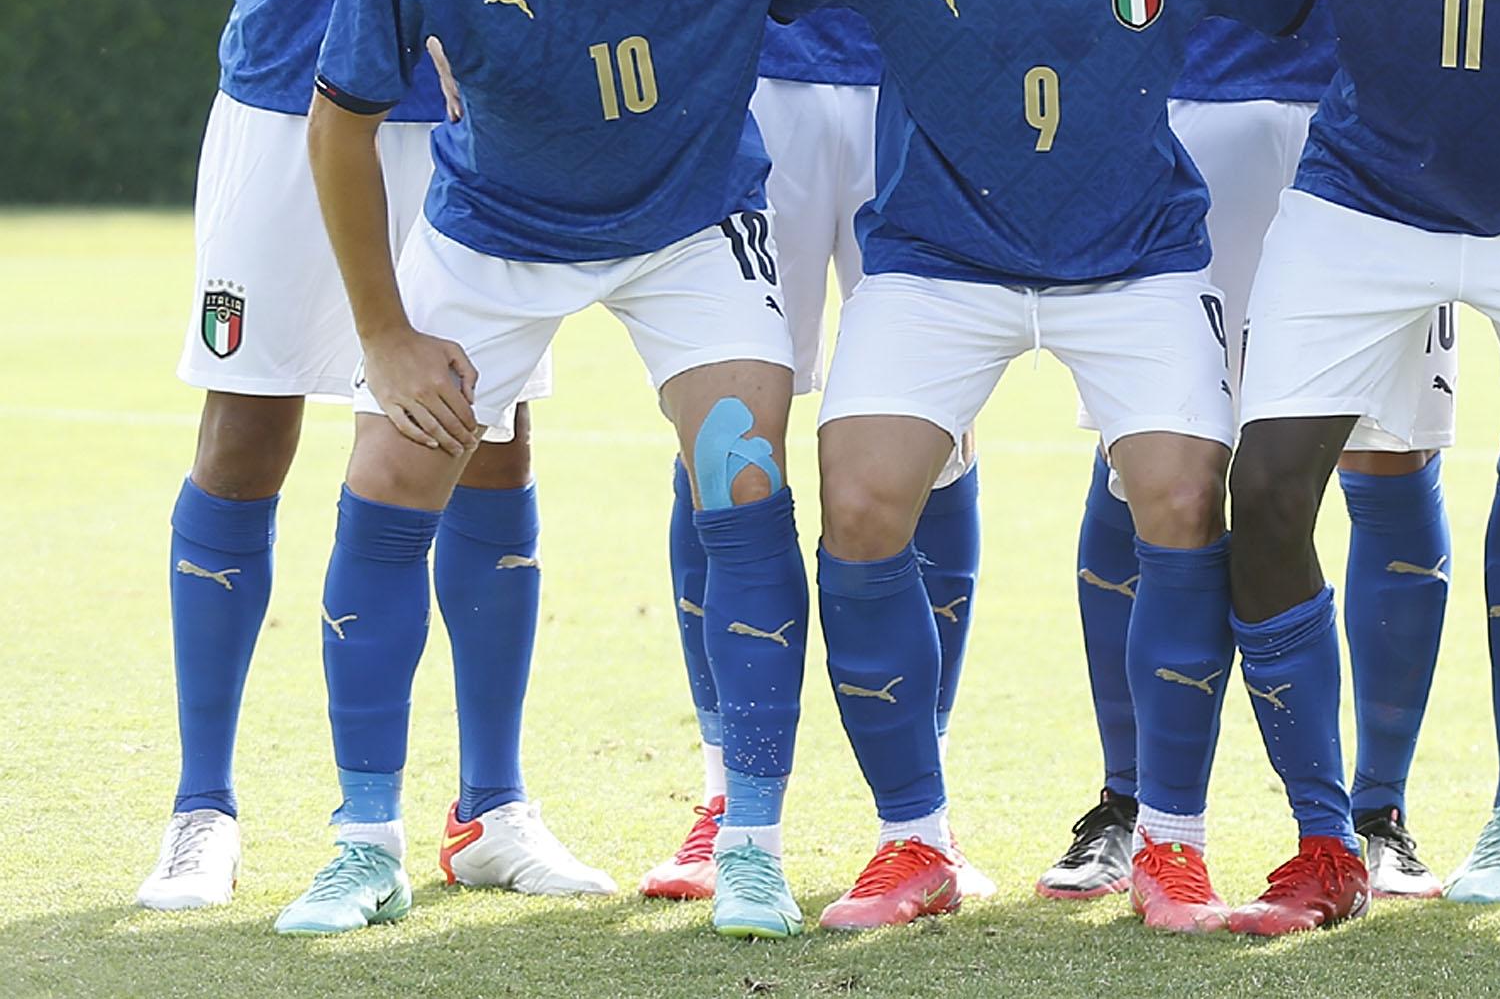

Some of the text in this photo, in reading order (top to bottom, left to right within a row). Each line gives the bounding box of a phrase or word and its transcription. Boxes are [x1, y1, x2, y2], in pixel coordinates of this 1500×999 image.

[588, 34, 659, 121] 10
[1024, 65, 1061, 153] 9
[719, 211, 778, 286] 10
[206, 294, 241, 310] ITALIA
